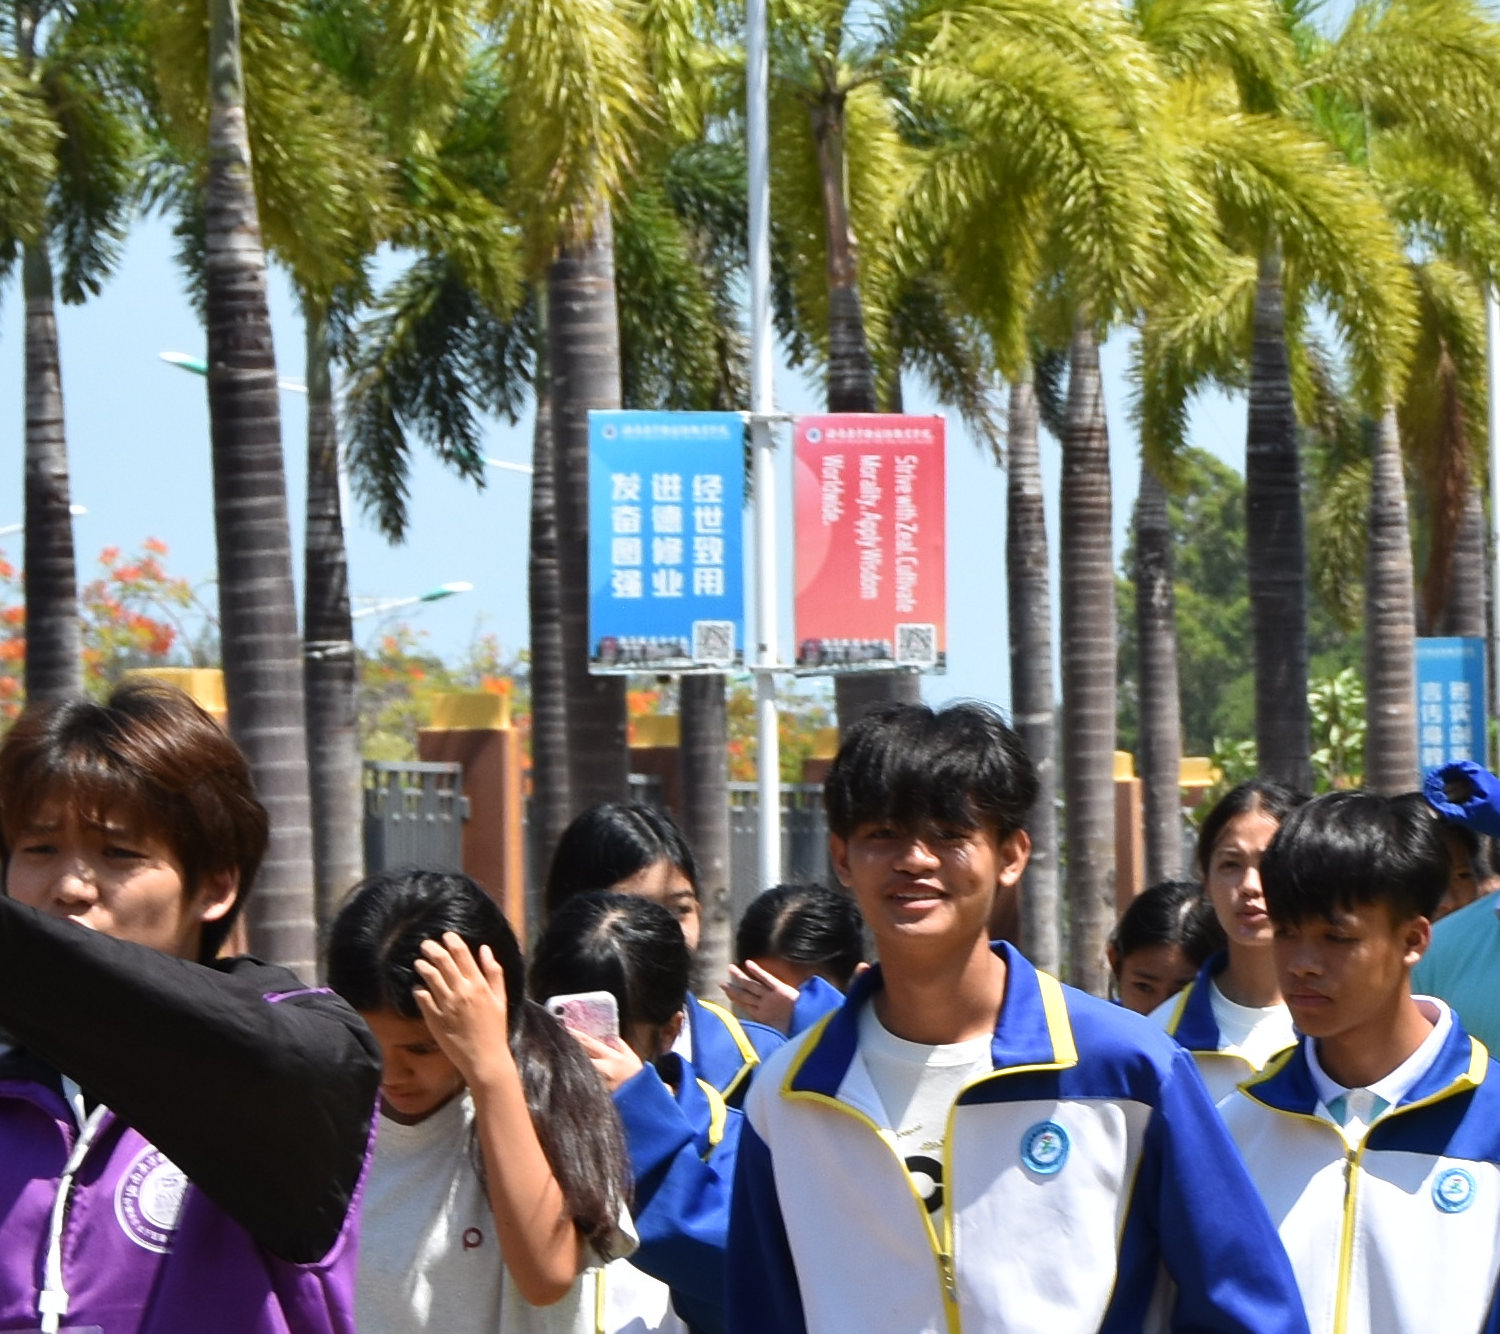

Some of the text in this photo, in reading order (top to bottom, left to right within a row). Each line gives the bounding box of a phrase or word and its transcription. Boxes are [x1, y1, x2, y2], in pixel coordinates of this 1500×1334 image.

[894, 455, 918, 494] Strive
[854, 511, 882, 548] Apply
[895, 495, 918, 521] with
[652, 473, 683, 597] 进德修业
[693, 474, 724, 596] 经世致用
[860, 549, 882, 600] Wisdom
[895, 556, 918, 612] Cultivate
